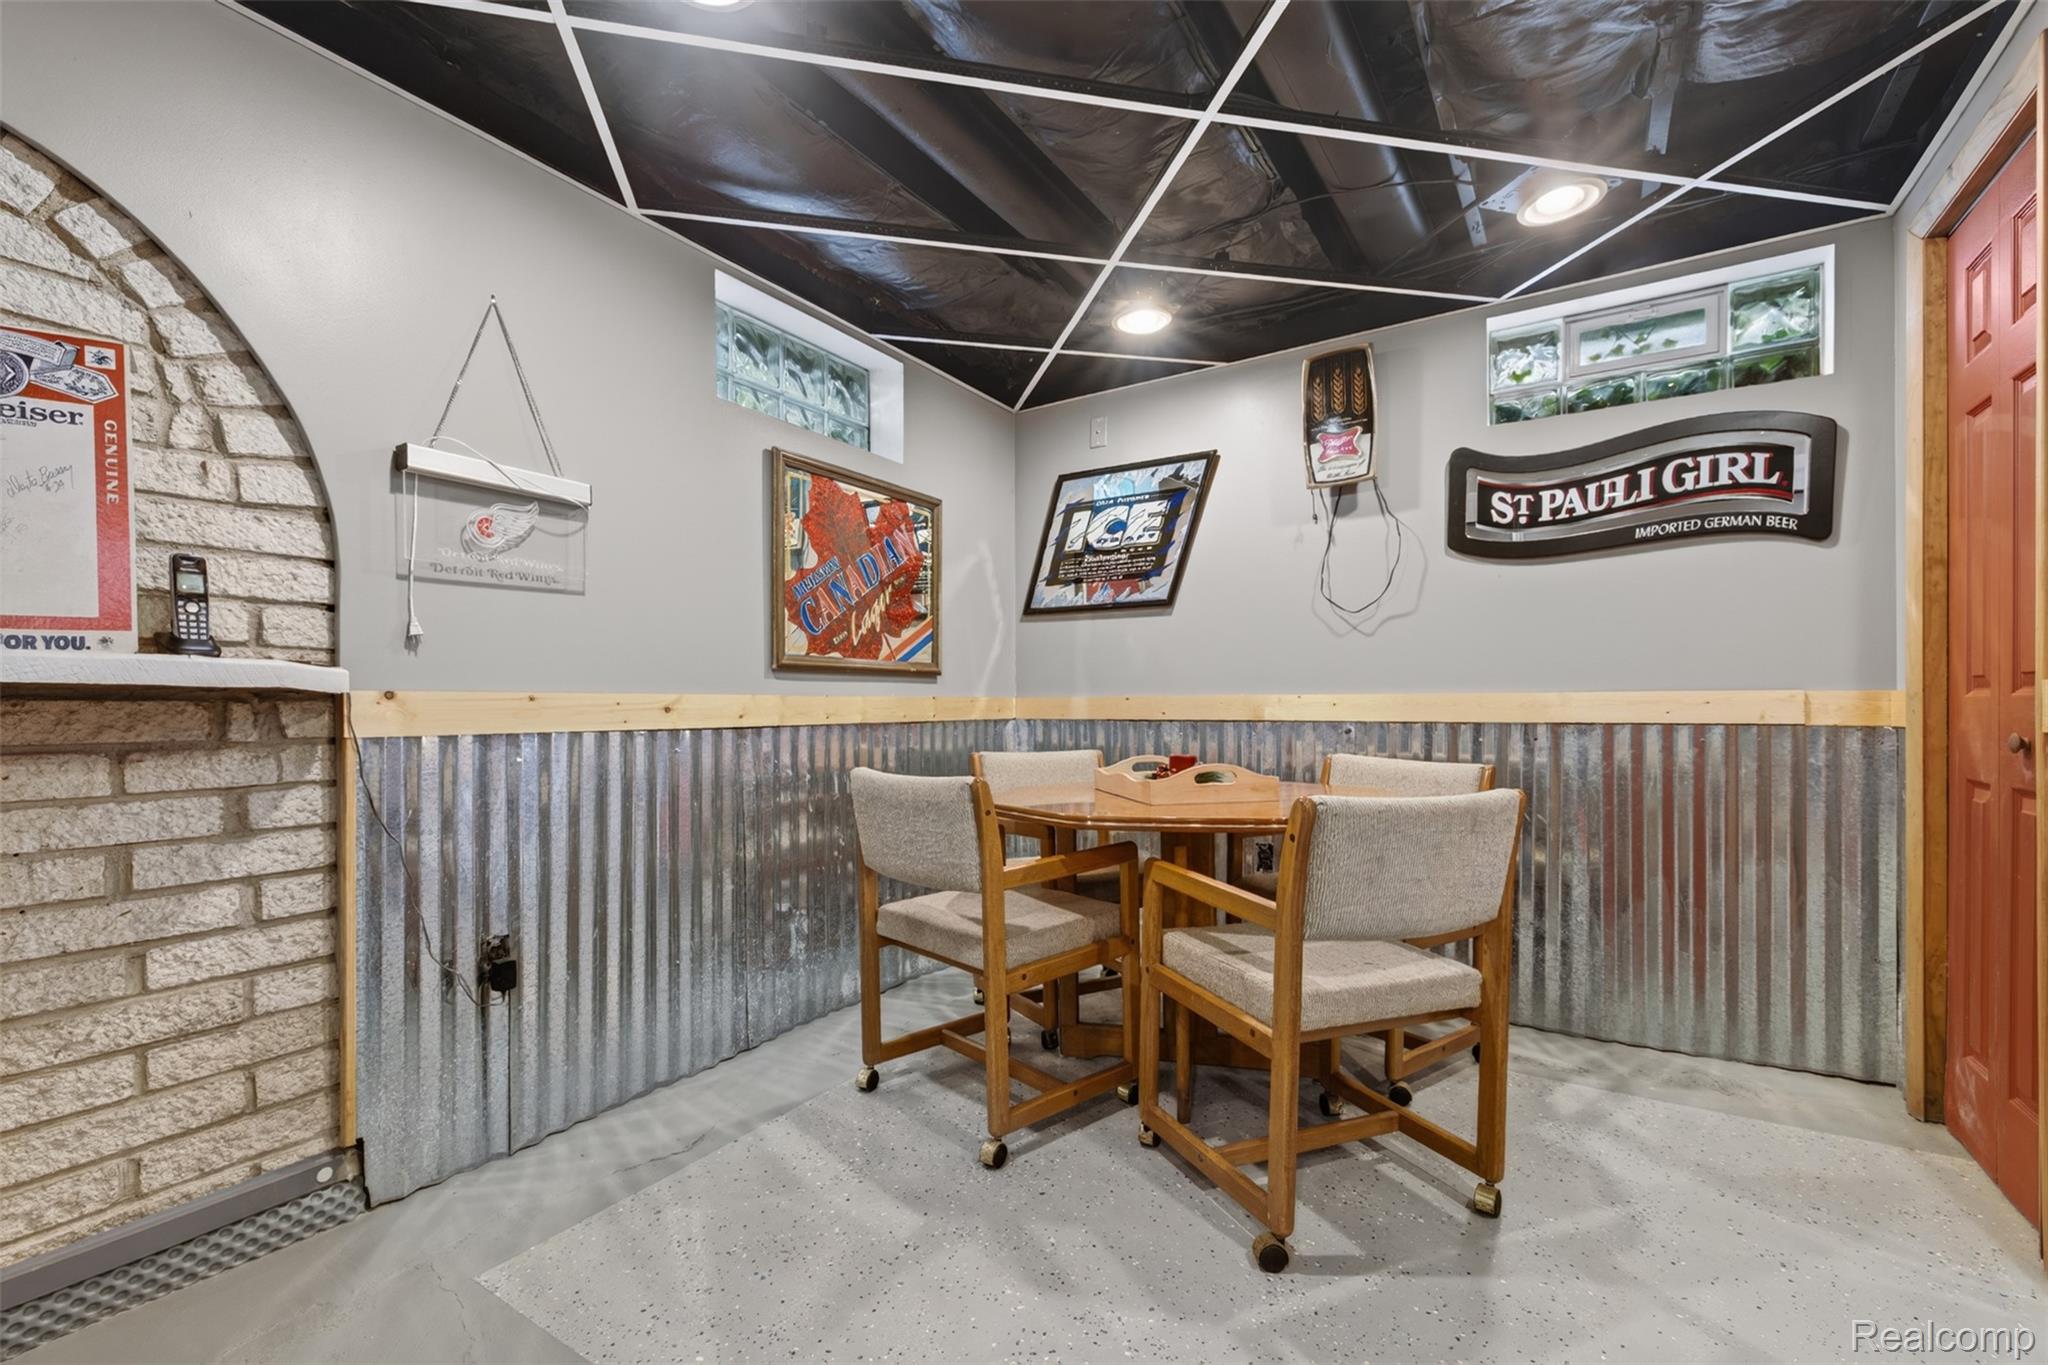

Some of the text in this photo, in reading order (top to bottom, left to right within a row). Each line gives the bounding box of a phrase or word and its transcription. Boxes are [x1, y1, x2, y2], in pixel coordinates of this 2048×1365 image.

[103, 419, 120, 505] GENUINE
[1538, 466, 1658, 522] PAULI
[1063, 498, 1168, 554] ICE
[1634, 514, 1799, 539] IMPORTED GERMAN BEER
[429, 561, 484, 577] Detroit
[487, 567, 514, 583] Red
[800, 523, 918, 636] CANADIAN
[0, 633, 91, 651] OR YOU.
